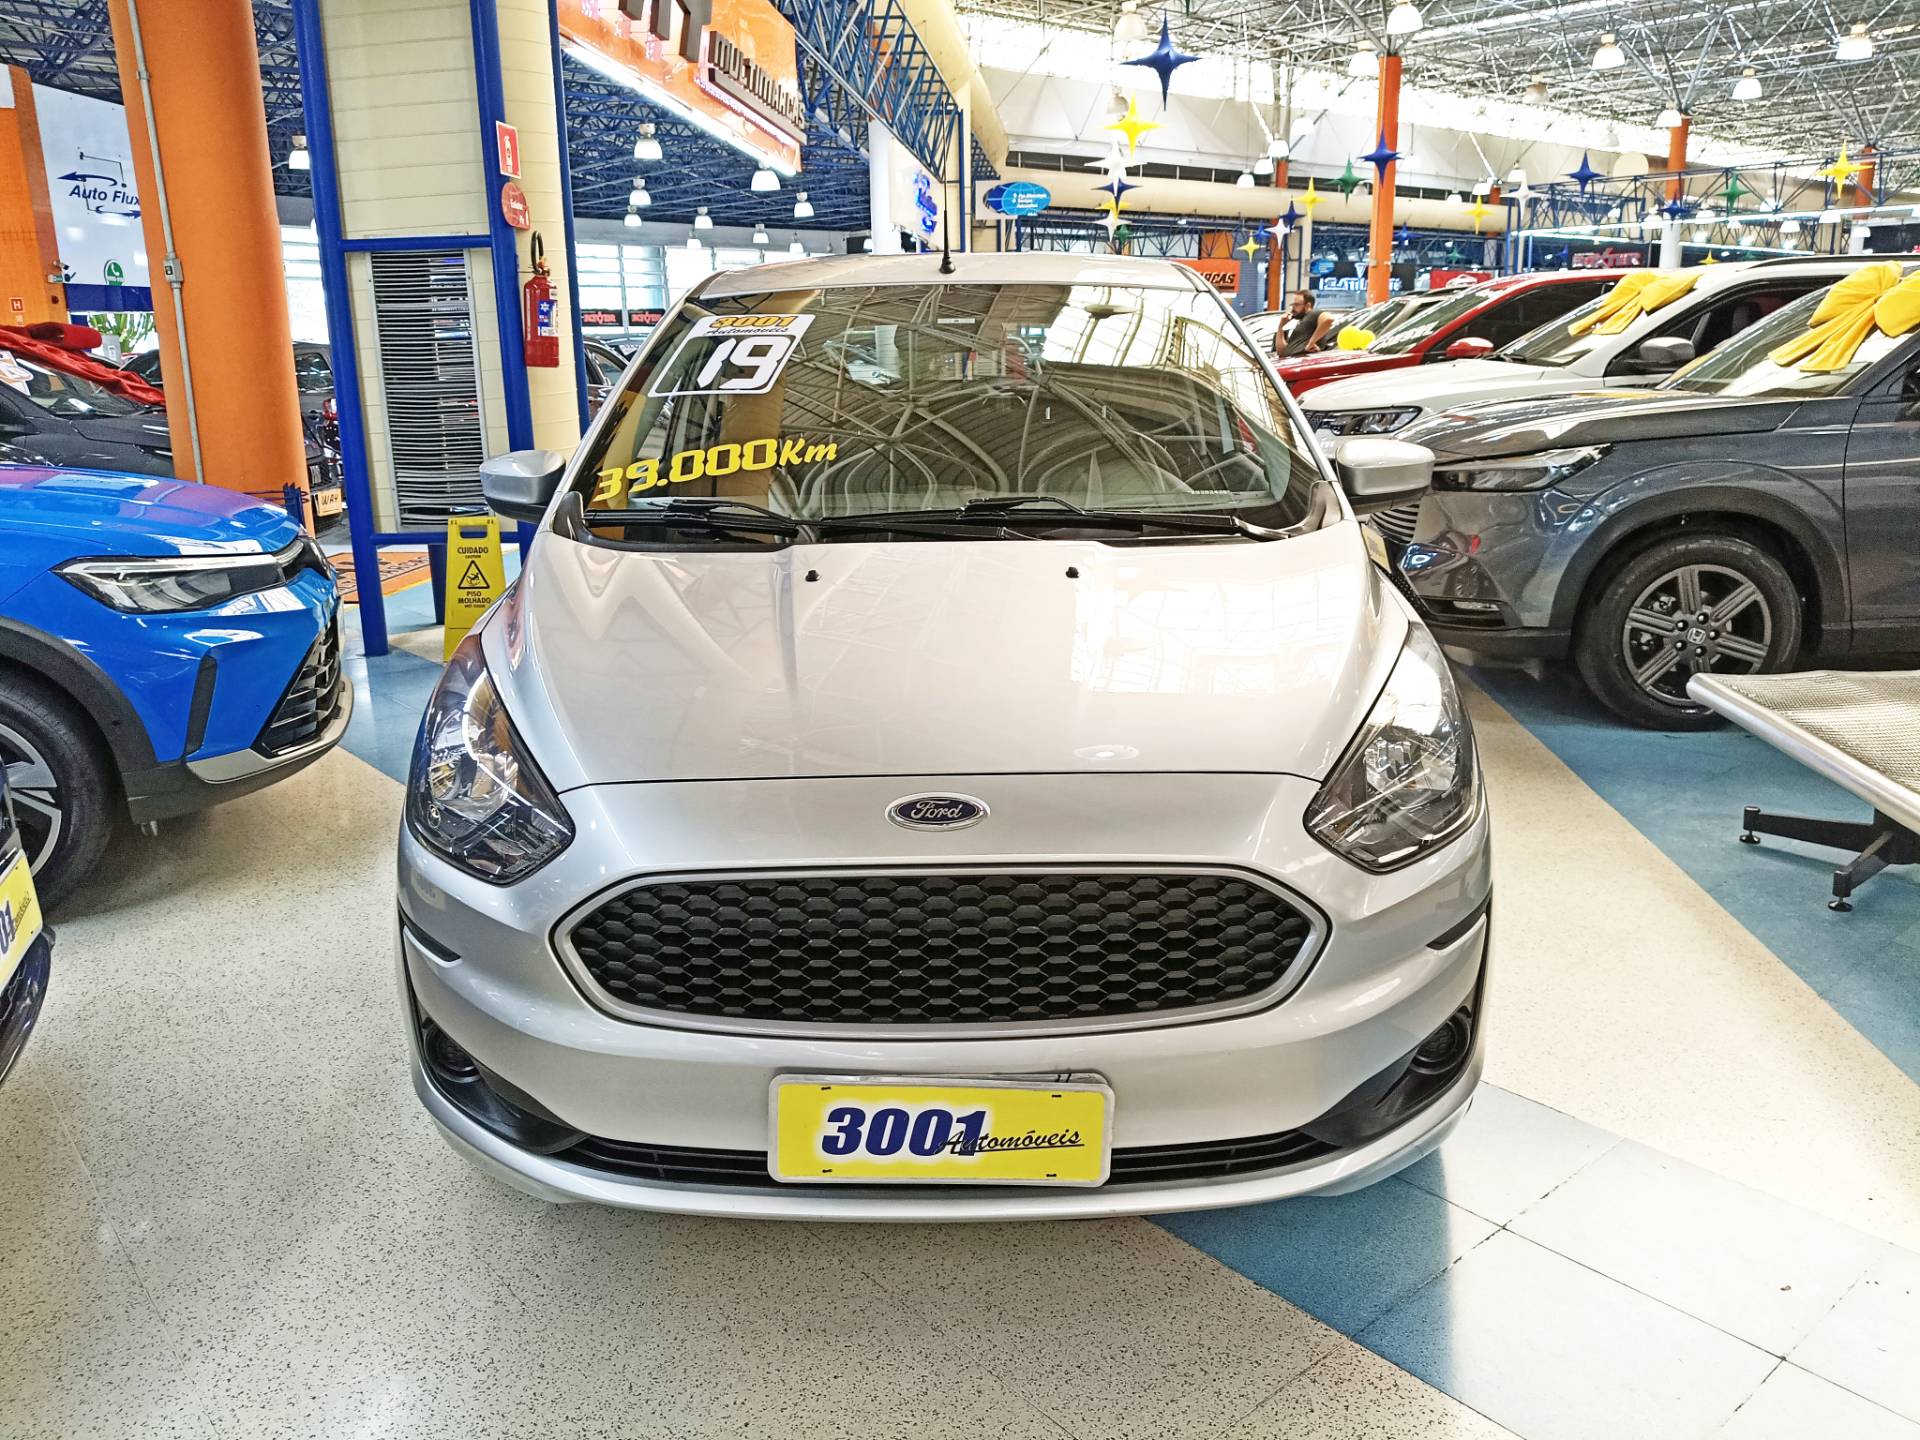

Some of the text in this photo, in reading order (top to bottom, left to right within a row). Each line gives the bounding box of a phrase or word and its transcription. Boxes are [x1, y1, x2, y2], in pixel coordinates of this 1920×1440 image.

[69, 184, 107, 201] Auto
[709, 316, 799, 328] 3001
[697, 336, 792, 390] 19
[457, 546, 489, 554] CUIDADO
[911, 800, 964, 819] Ford
[821, 1106, 1083, 1157] 3001 Automóveis
